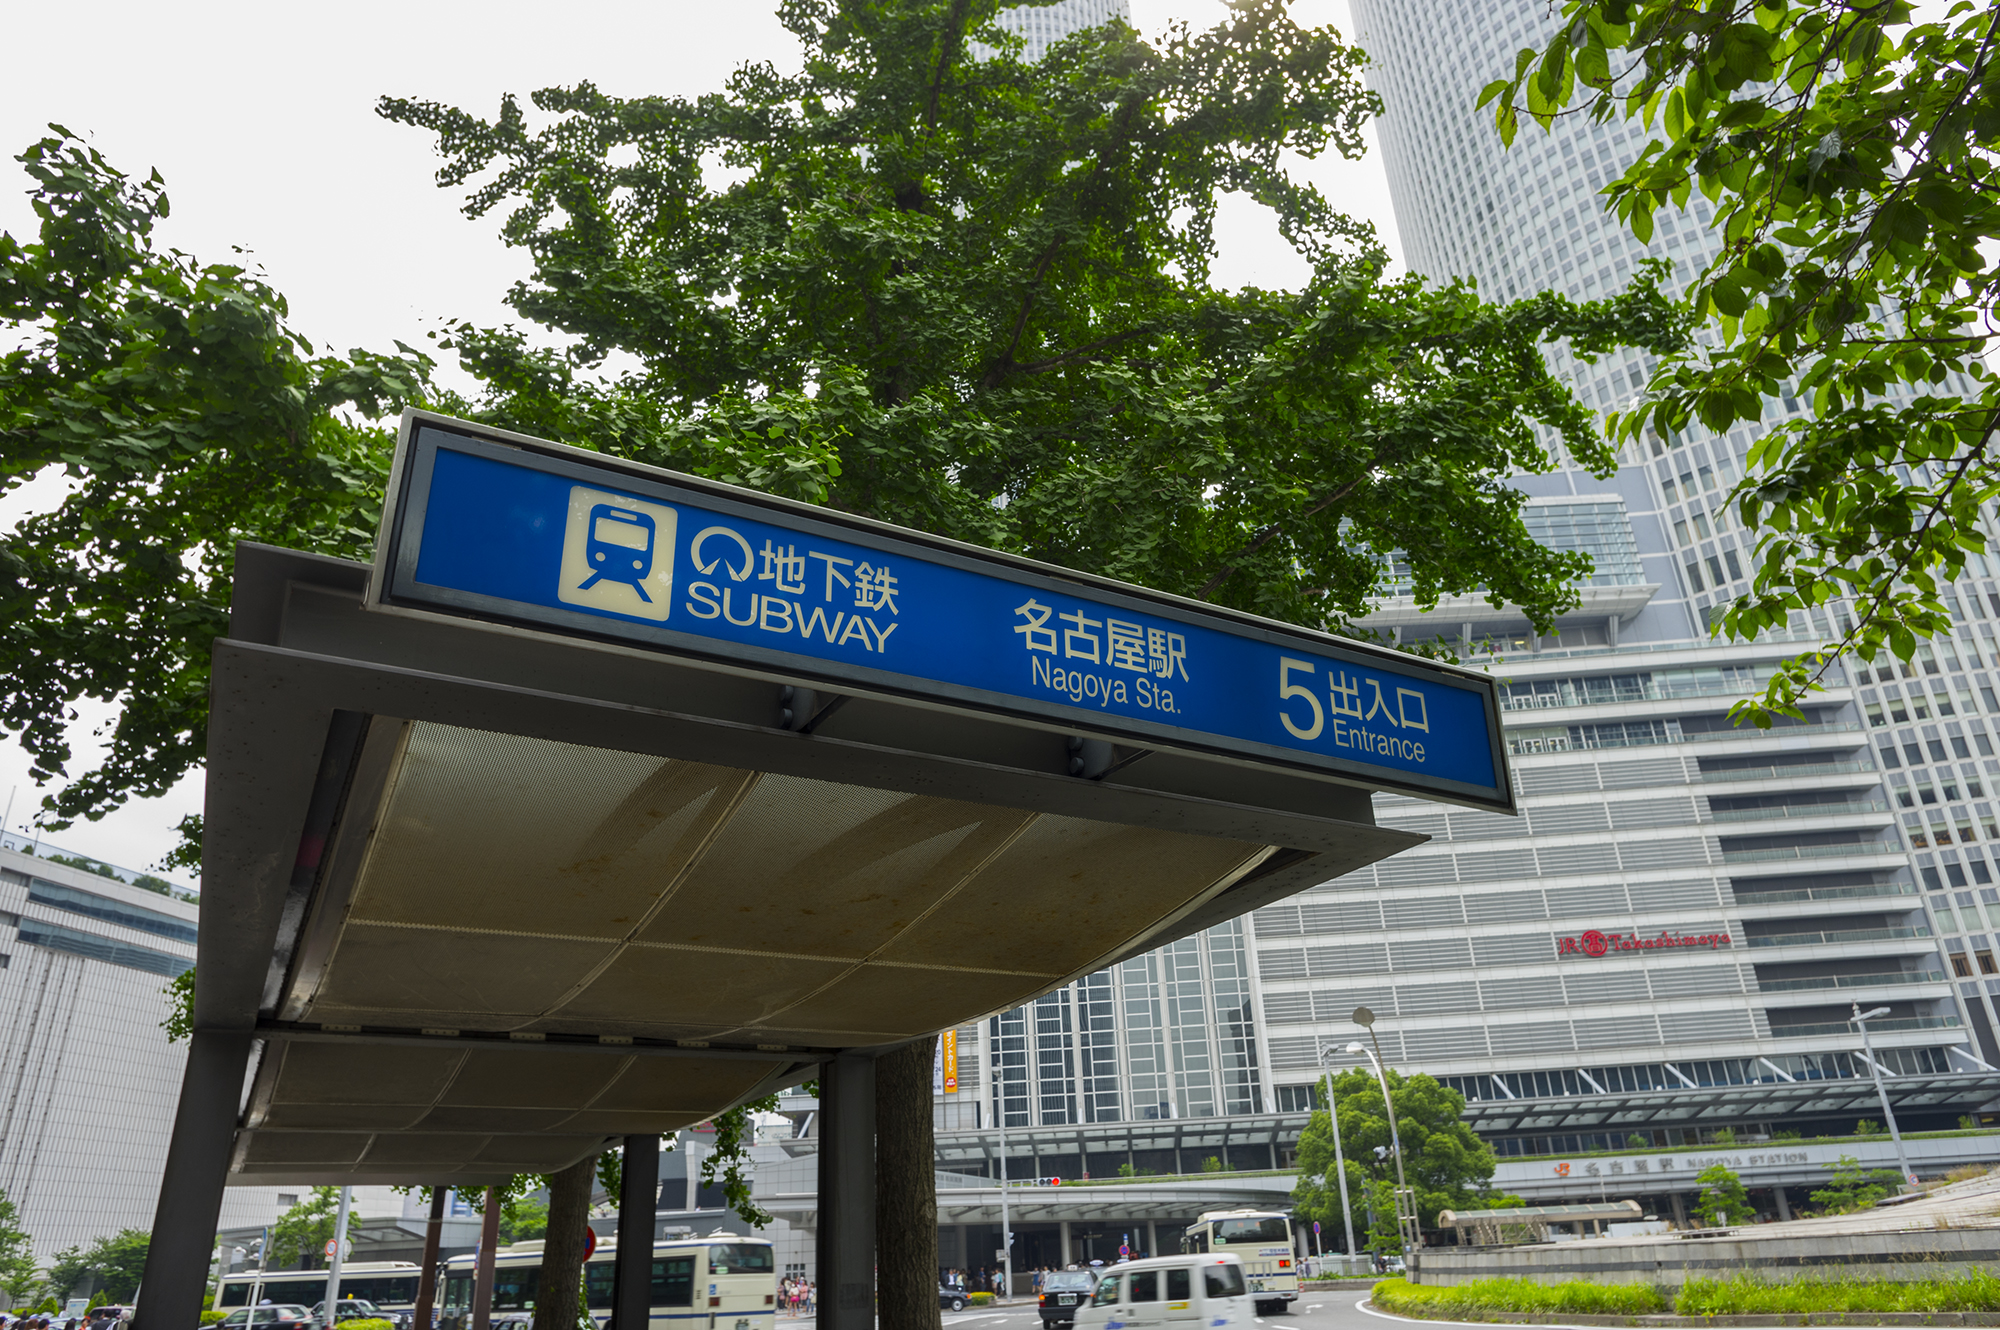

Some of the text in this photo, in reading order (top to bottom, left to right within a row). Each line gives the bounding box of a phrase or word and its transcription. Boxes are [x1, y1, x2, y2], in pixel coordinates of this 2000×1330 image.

[757, 539, 900, 616] 地下鉄
[685, 581, 899, 654] SUBWAY
[1013, 598, 1190, 683] 名古屋駅
[1032, 655, 1182, 715] Nagoya Sta.
[1279, 656, 1324, 740] 5
[1328, 670, 1430, 734] 出入口
[1333, 718, 1425, 763] Entrance
[1558, 937, 1581, 954] JR
[1608, 931, 1732, 950] Takashimaya
[1687, 1152, 1809, 1168] NAGOYA STATION
